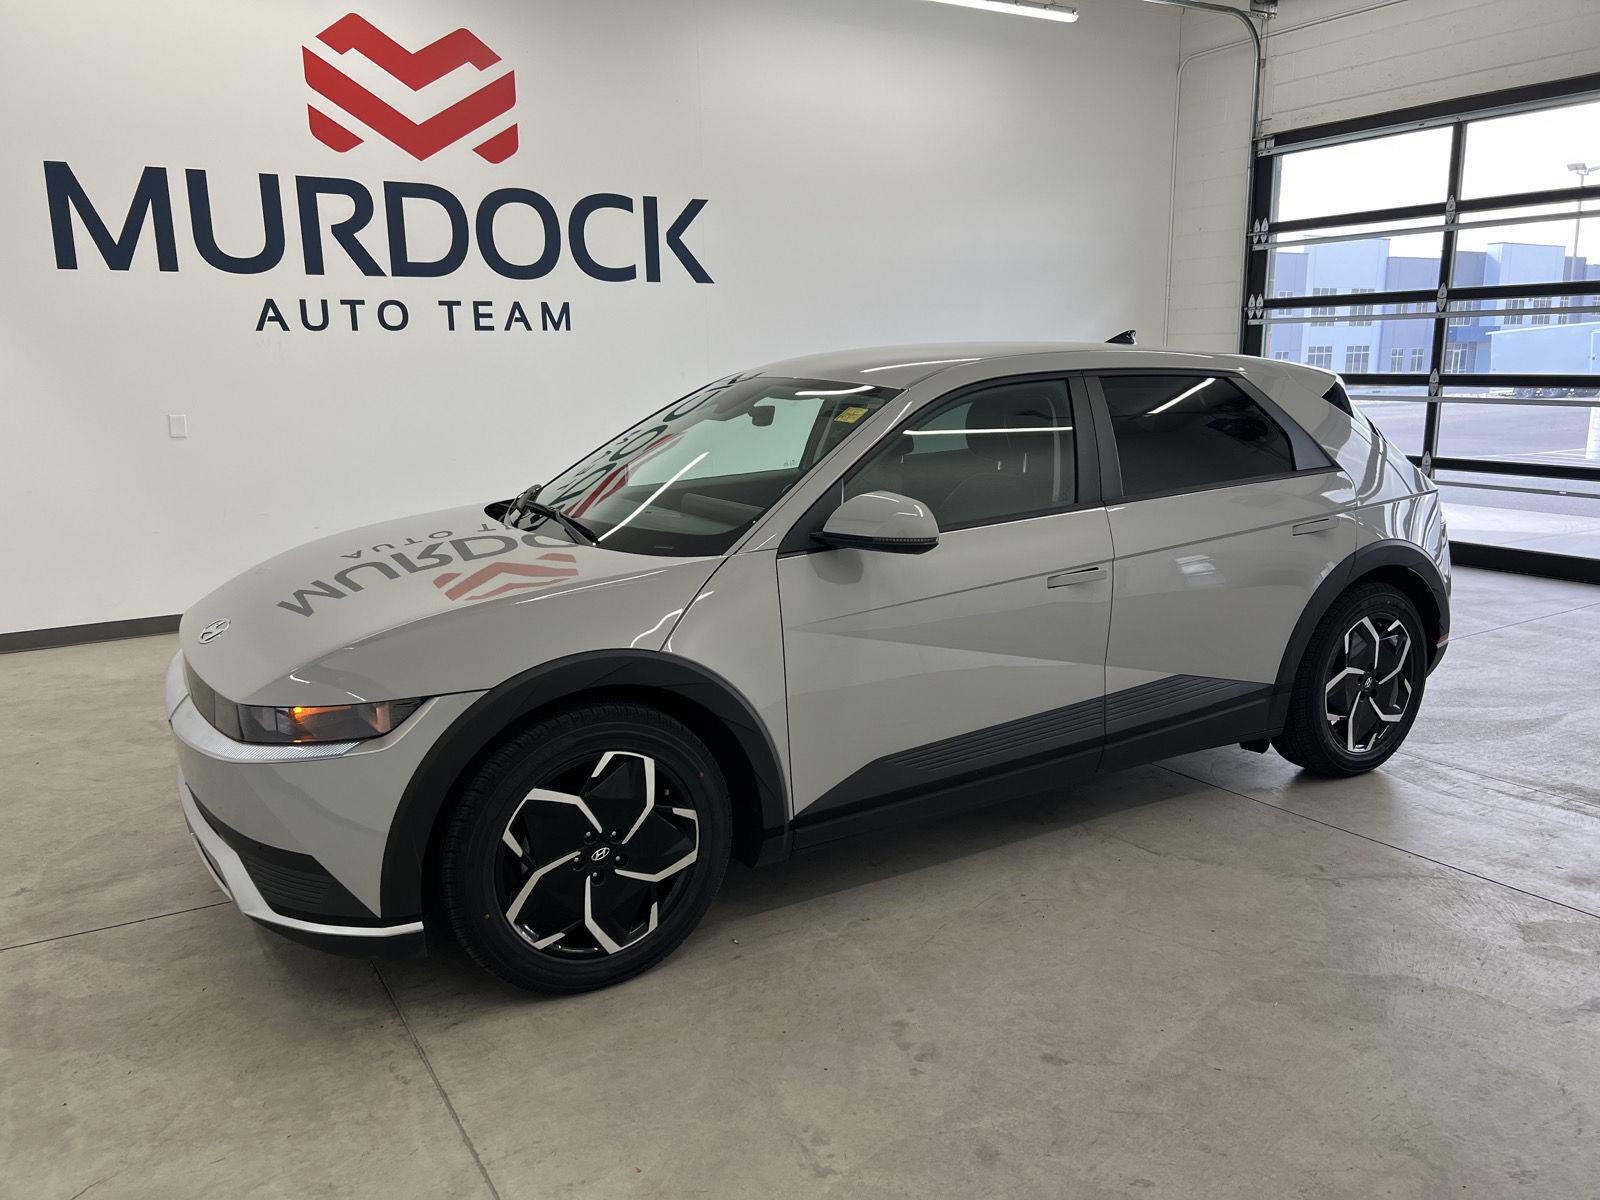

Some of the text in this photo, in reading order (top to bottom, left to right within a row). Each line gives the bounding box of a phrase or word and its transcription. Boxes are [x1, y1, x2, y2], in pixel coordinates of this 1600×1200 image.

[44, 161, 714, 283] MURDOCK
[256, 298, 571, 332] AUTO TEAM
